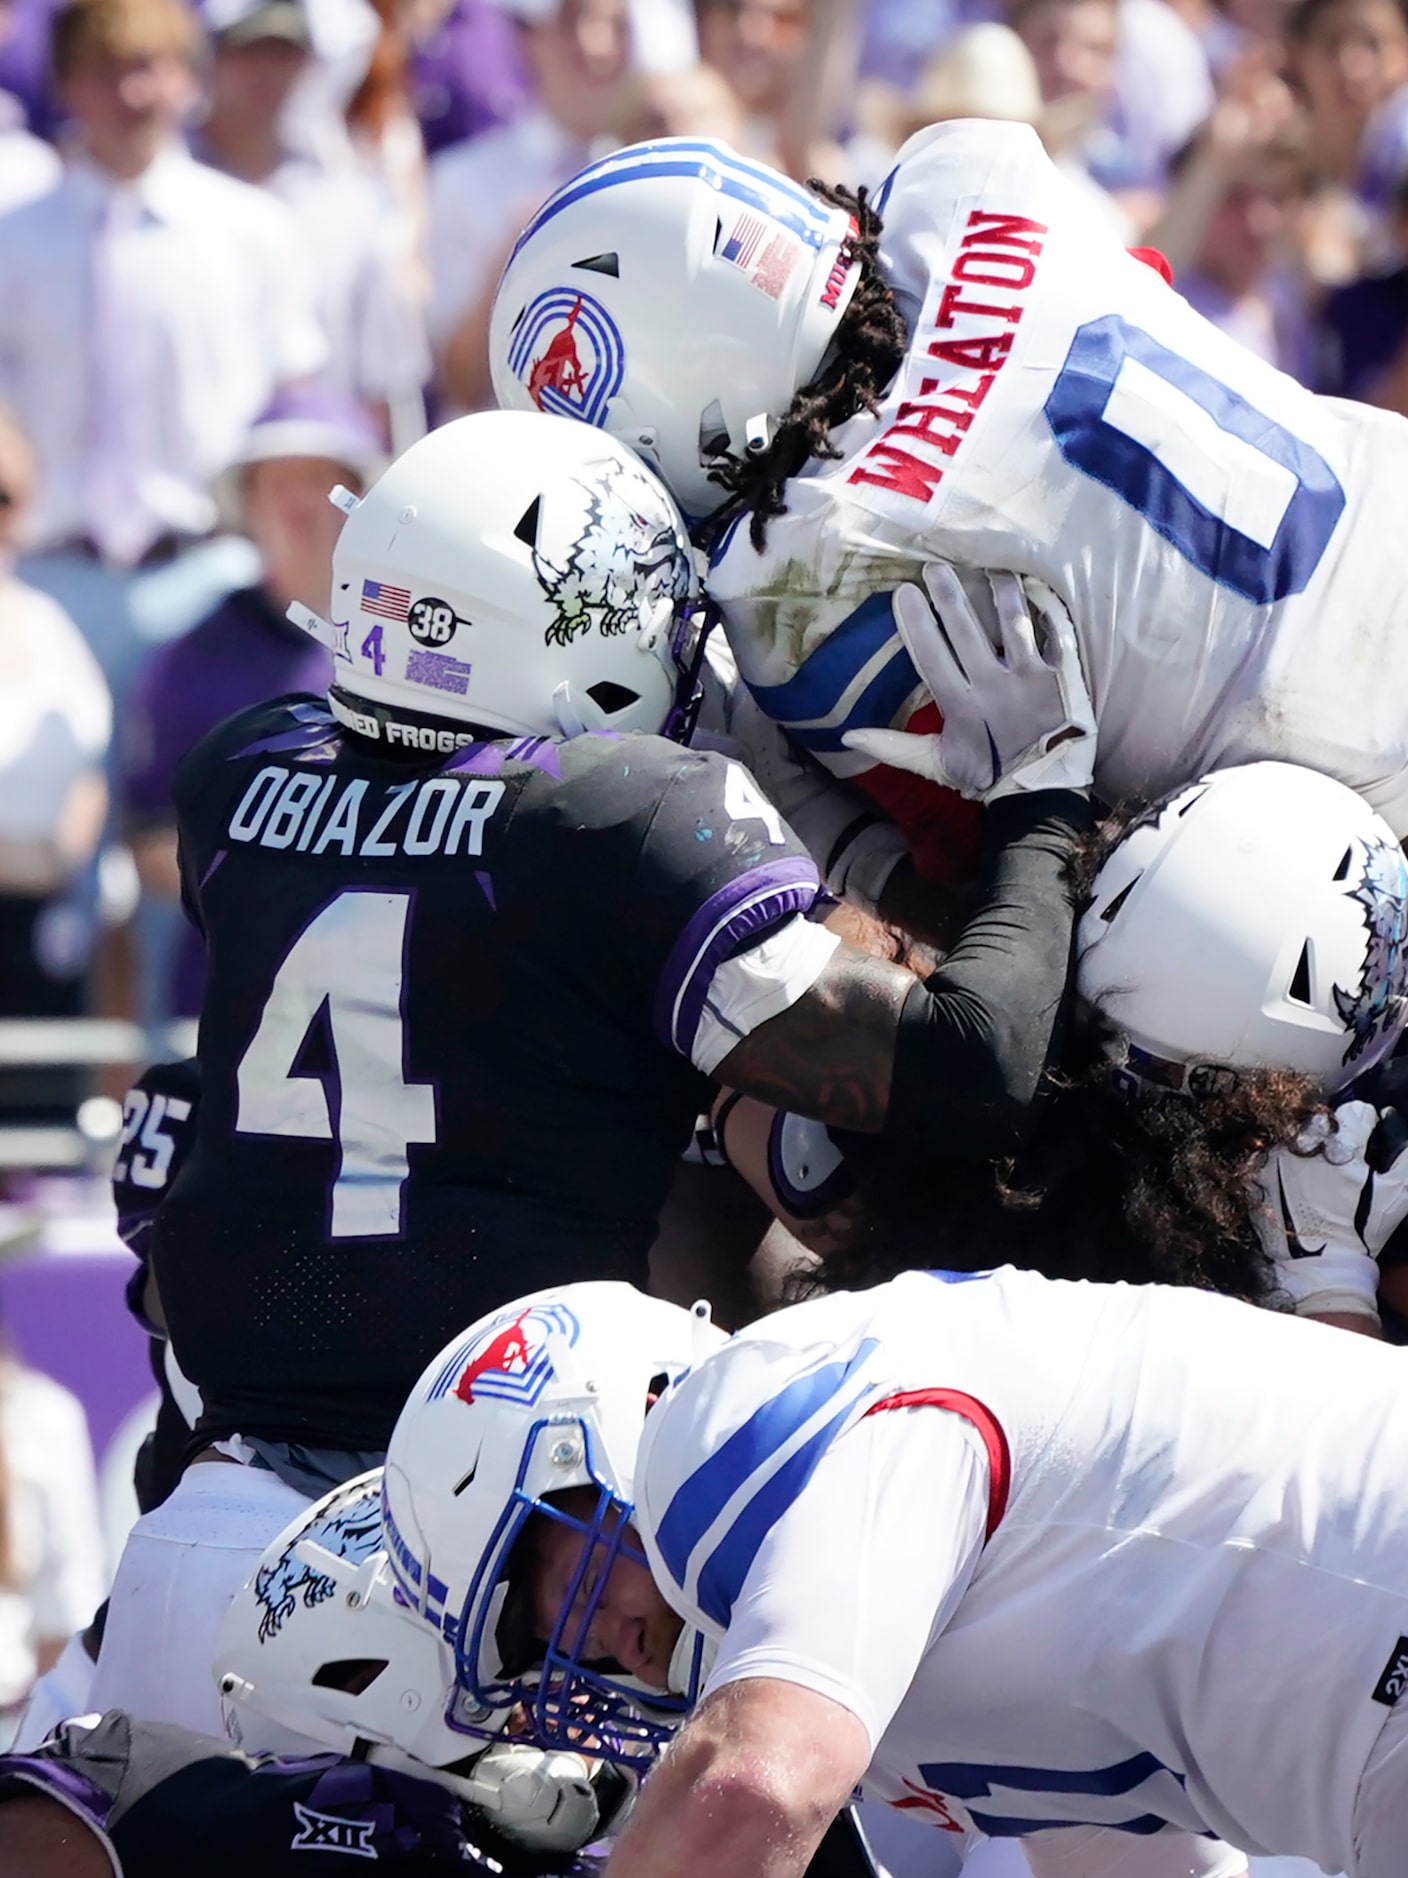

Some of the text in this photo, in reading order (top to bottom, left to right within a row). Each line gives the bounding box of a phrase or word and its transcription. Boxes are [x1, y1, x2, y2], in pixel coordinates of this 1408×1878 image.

[847, 209, 1048, 503] WHEATON
[1043, 314, 1346, 606] 0
[361, 624, 386, 676] 4
[410, 603, 453, 643] 38
[384, 720, 474, 754] FROGS
[228, 765, 506, 857] OBIAZOR
[724, 762, 786, 845] 4
[235, 891, 437, 1238] 4
[113, 1089, 192, 1189] 25
